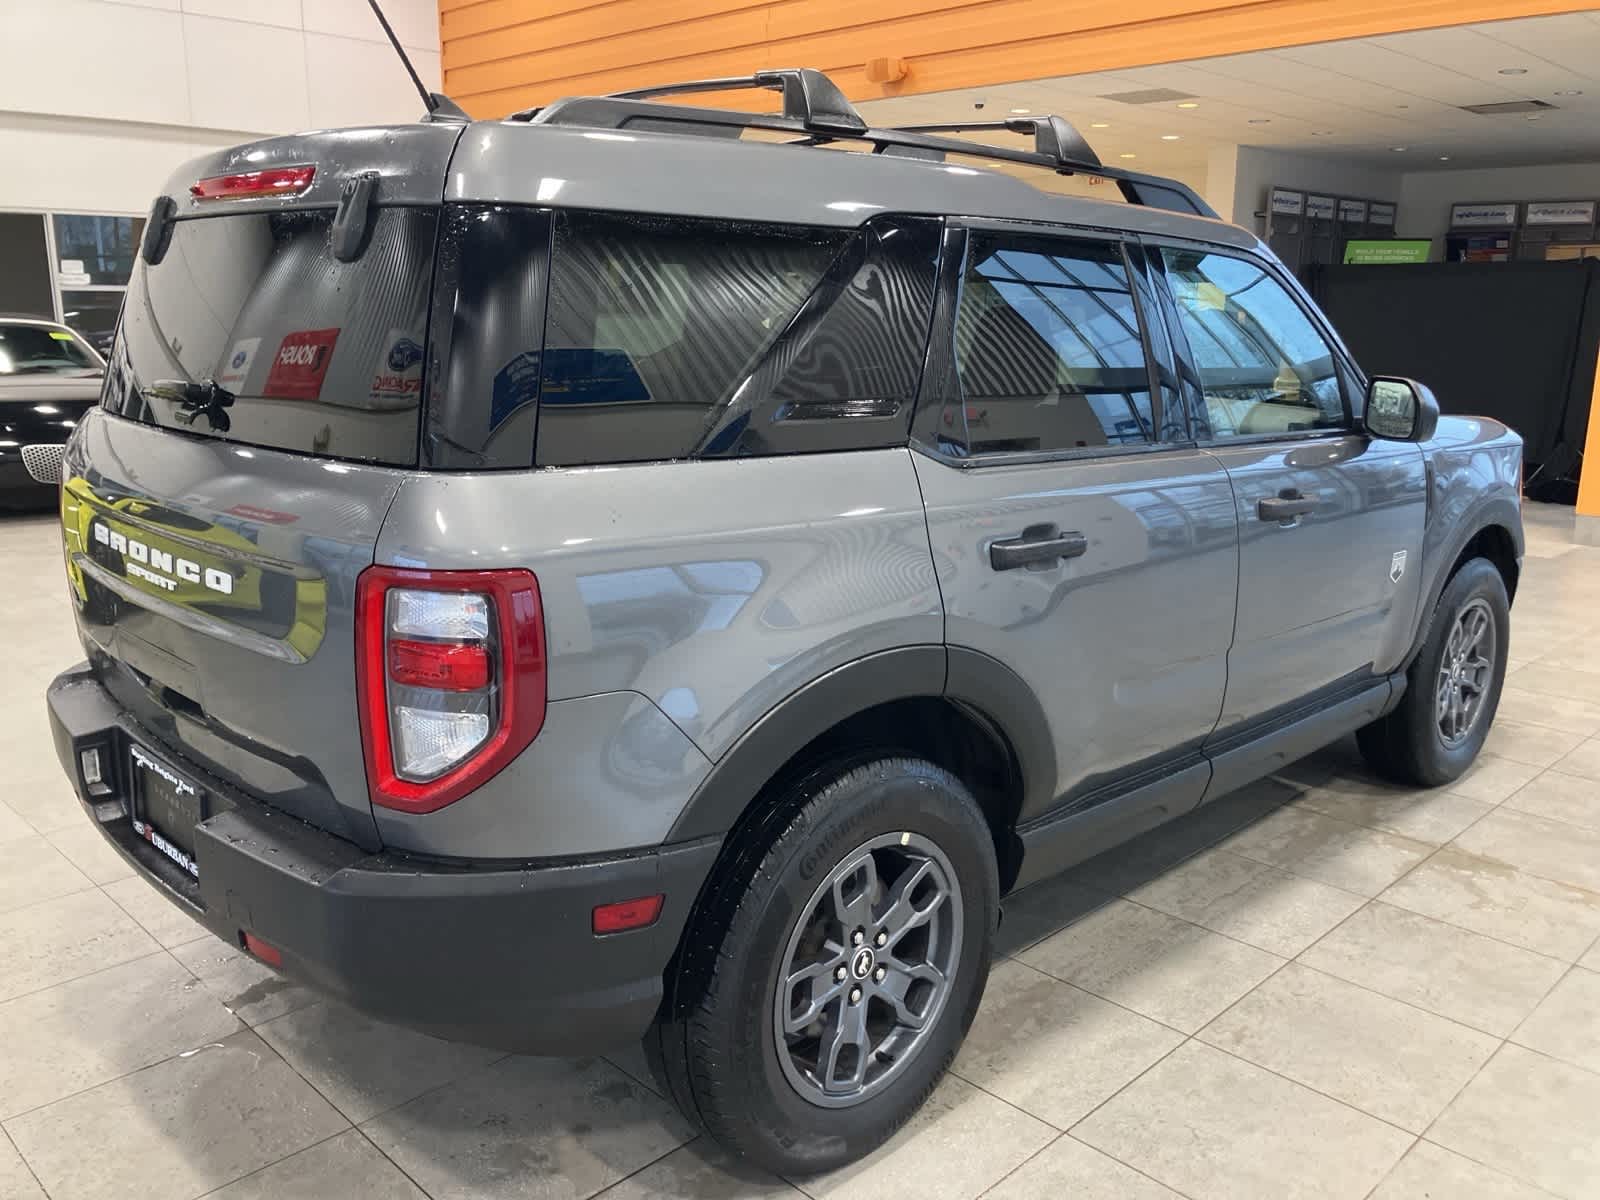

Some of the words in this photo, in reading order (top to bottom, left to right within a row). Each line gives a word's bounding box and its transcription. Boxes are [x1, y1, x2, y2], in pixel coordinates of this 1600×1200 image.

[94, 522, 233, 595] BRONCO
[126, 562, 178, 592] SPORT
[143, 823, 190, 870] SUBURBAN
